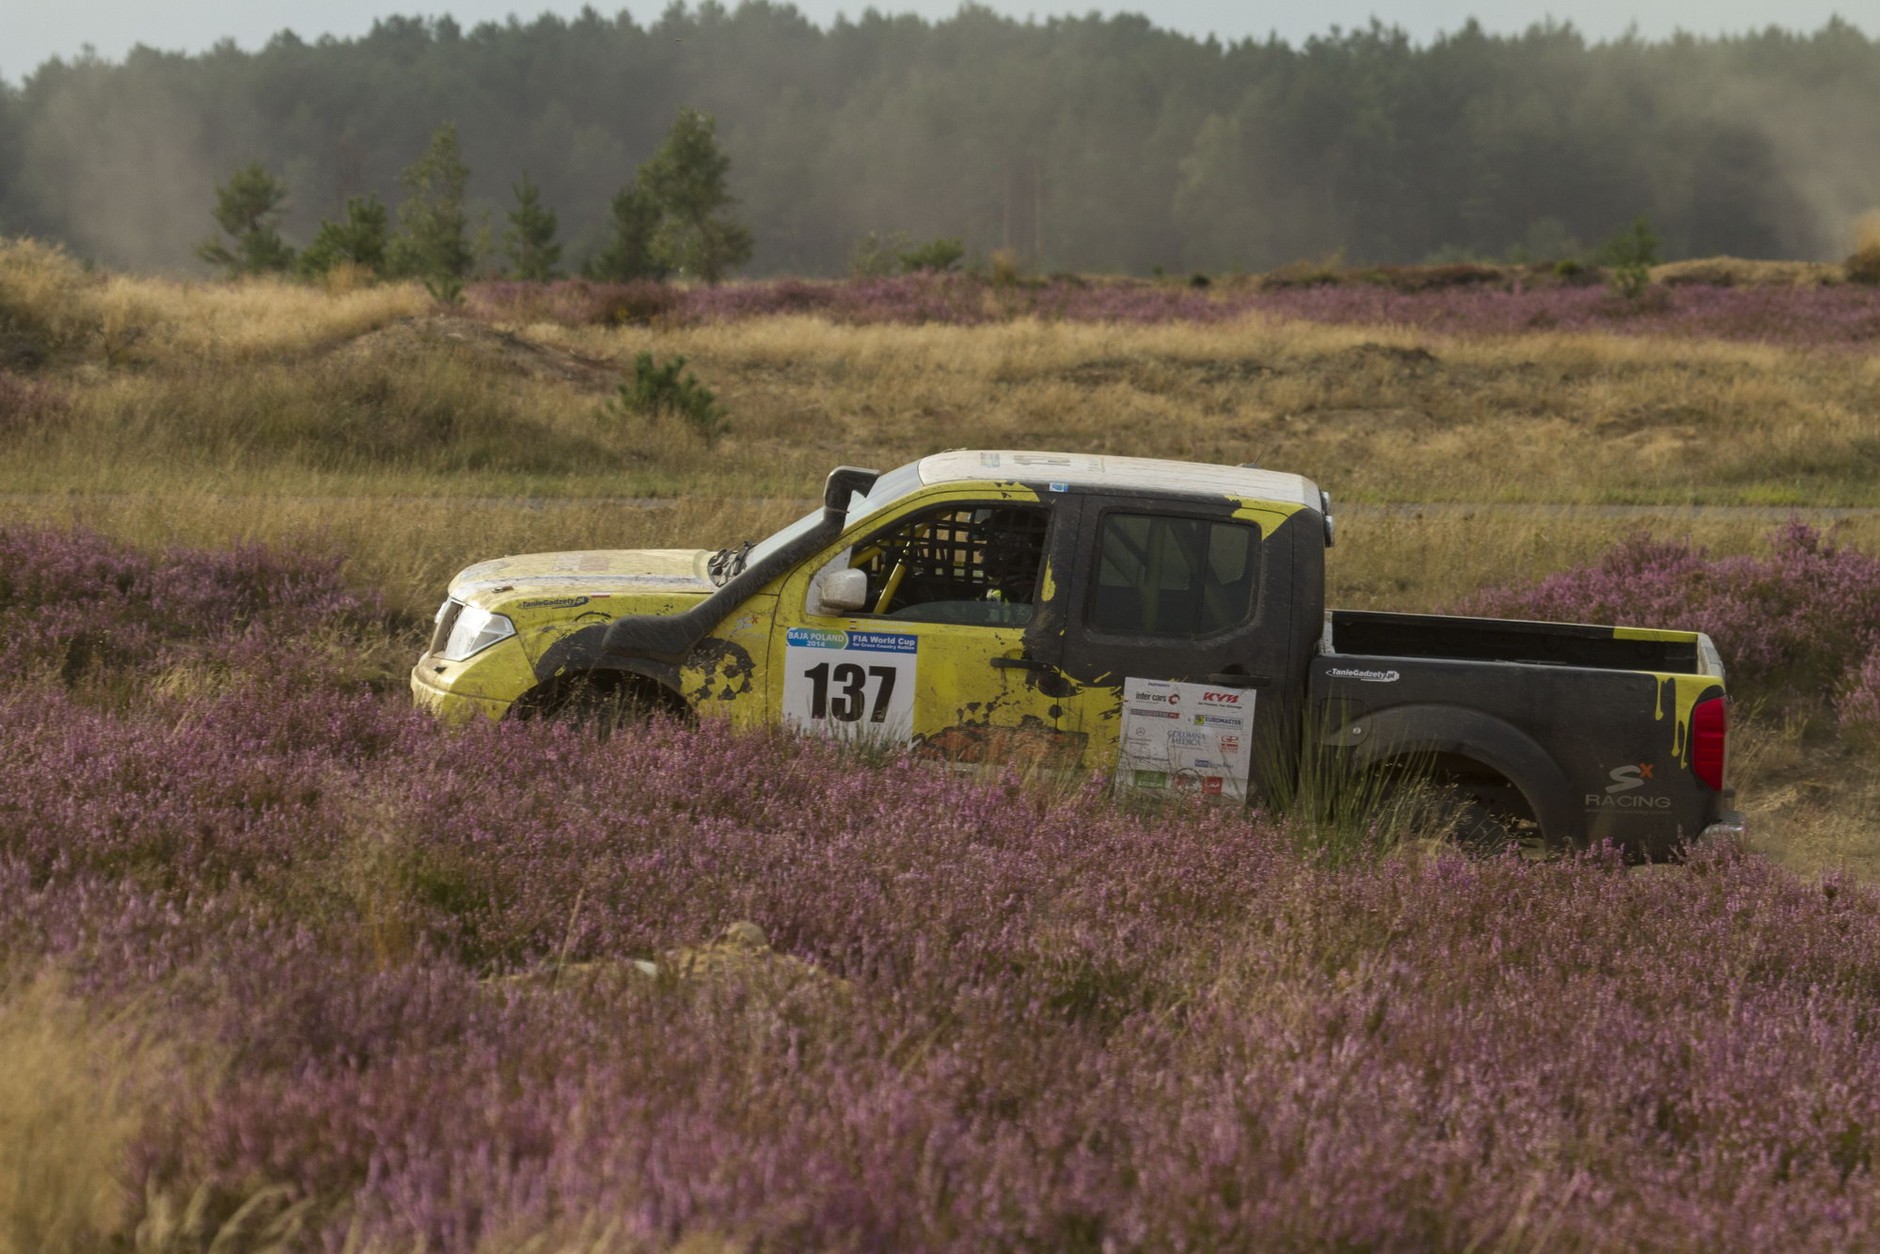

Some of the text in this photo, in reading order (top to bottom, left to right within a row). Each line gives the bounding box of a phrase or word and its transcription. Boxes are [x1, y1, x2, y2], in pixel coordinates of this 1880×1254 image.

[788, 631, 845, 642] BAJA POLAND
[852, 635, 916, 647] FIA World Cup
[804, 662, 897, 723] 137
[1135, 691, 1167, 702] inter cars
[1202, 691, 1239, 703] KYB
[1585, 794, 1672, 808] RACING
